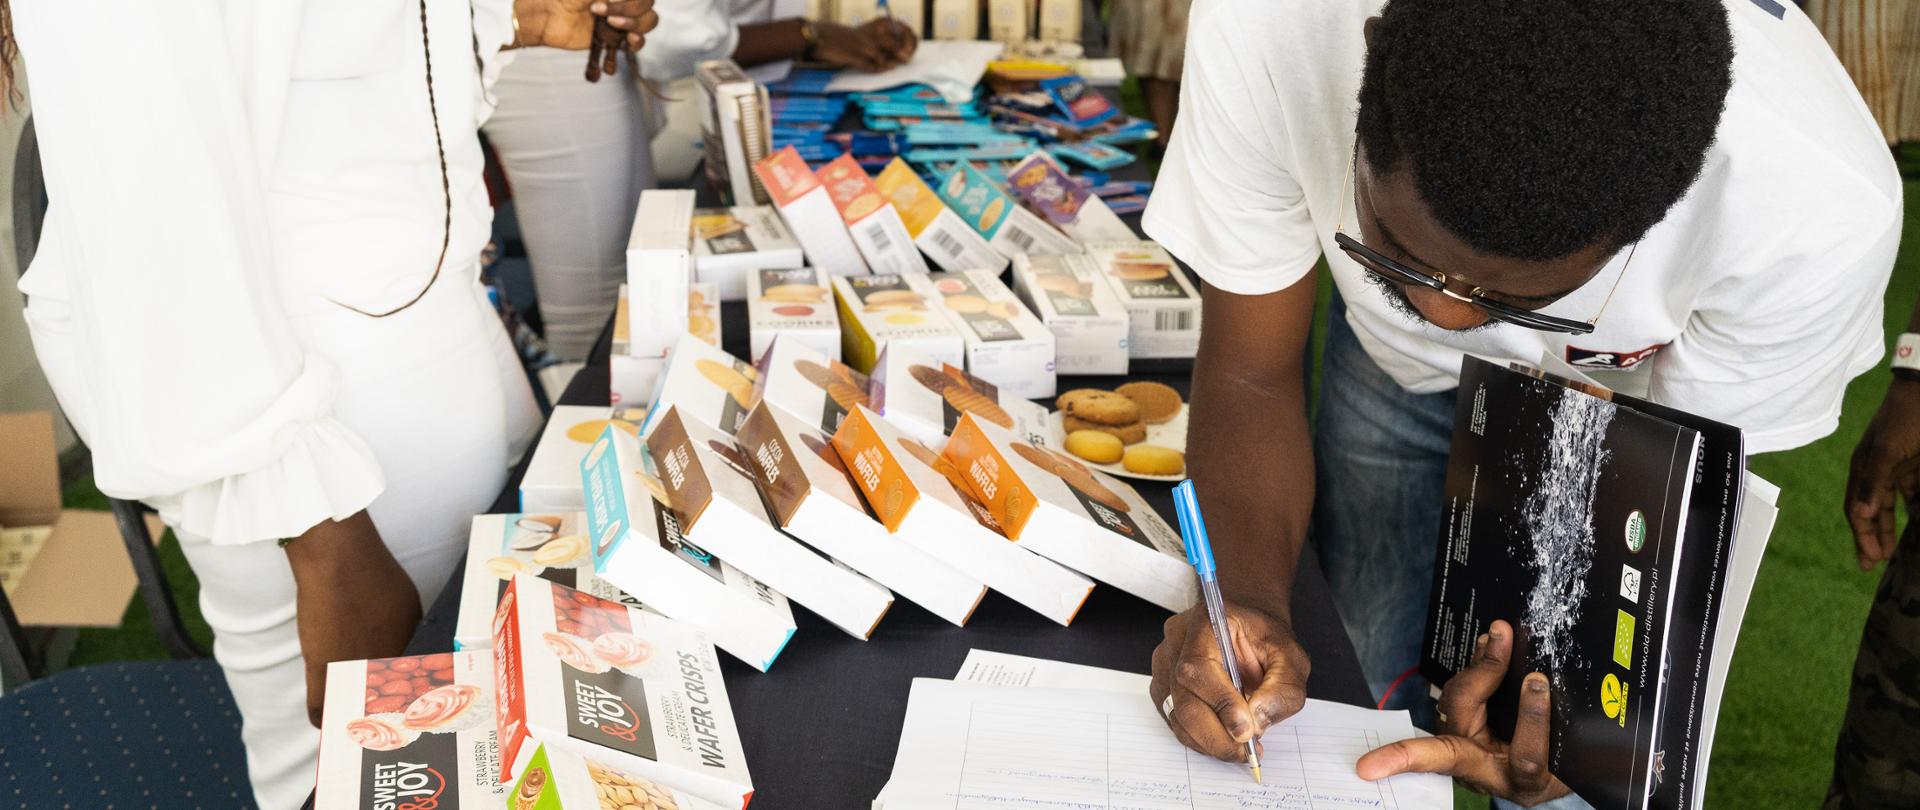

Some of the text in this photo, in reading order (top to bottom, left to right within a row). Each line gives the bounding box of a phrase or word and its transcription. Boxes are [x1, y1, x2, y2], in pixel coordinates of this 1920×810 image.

[664, 449, 685, 490] WAFFLES
[757, 442, 780, 484] WAFFLES
[854, 451, 880, 492] WAFFLES
[969, 459, 997, 500] WAFFLES
[1695, 435, 1706, 484] NOUS
[1725, 473, 1731, 486] 30
[1629, 517, 1637, 542] USDA
[1639, 567, 1659, 689] www.old-distillery.pl
[678, 650, 710, 705] CRISPS
[574, 679, 599, 728] SWEET
[594, 686, 632, 728] JOY
[1620, 682, 1629, 727] VEGAN
[690, 704, 726, 769] WAFER
[397, 762, 436, 797] JOY
[475, 741, 488, 786] STRAWBERRY
[374, 763, 397, 810] SWEET
